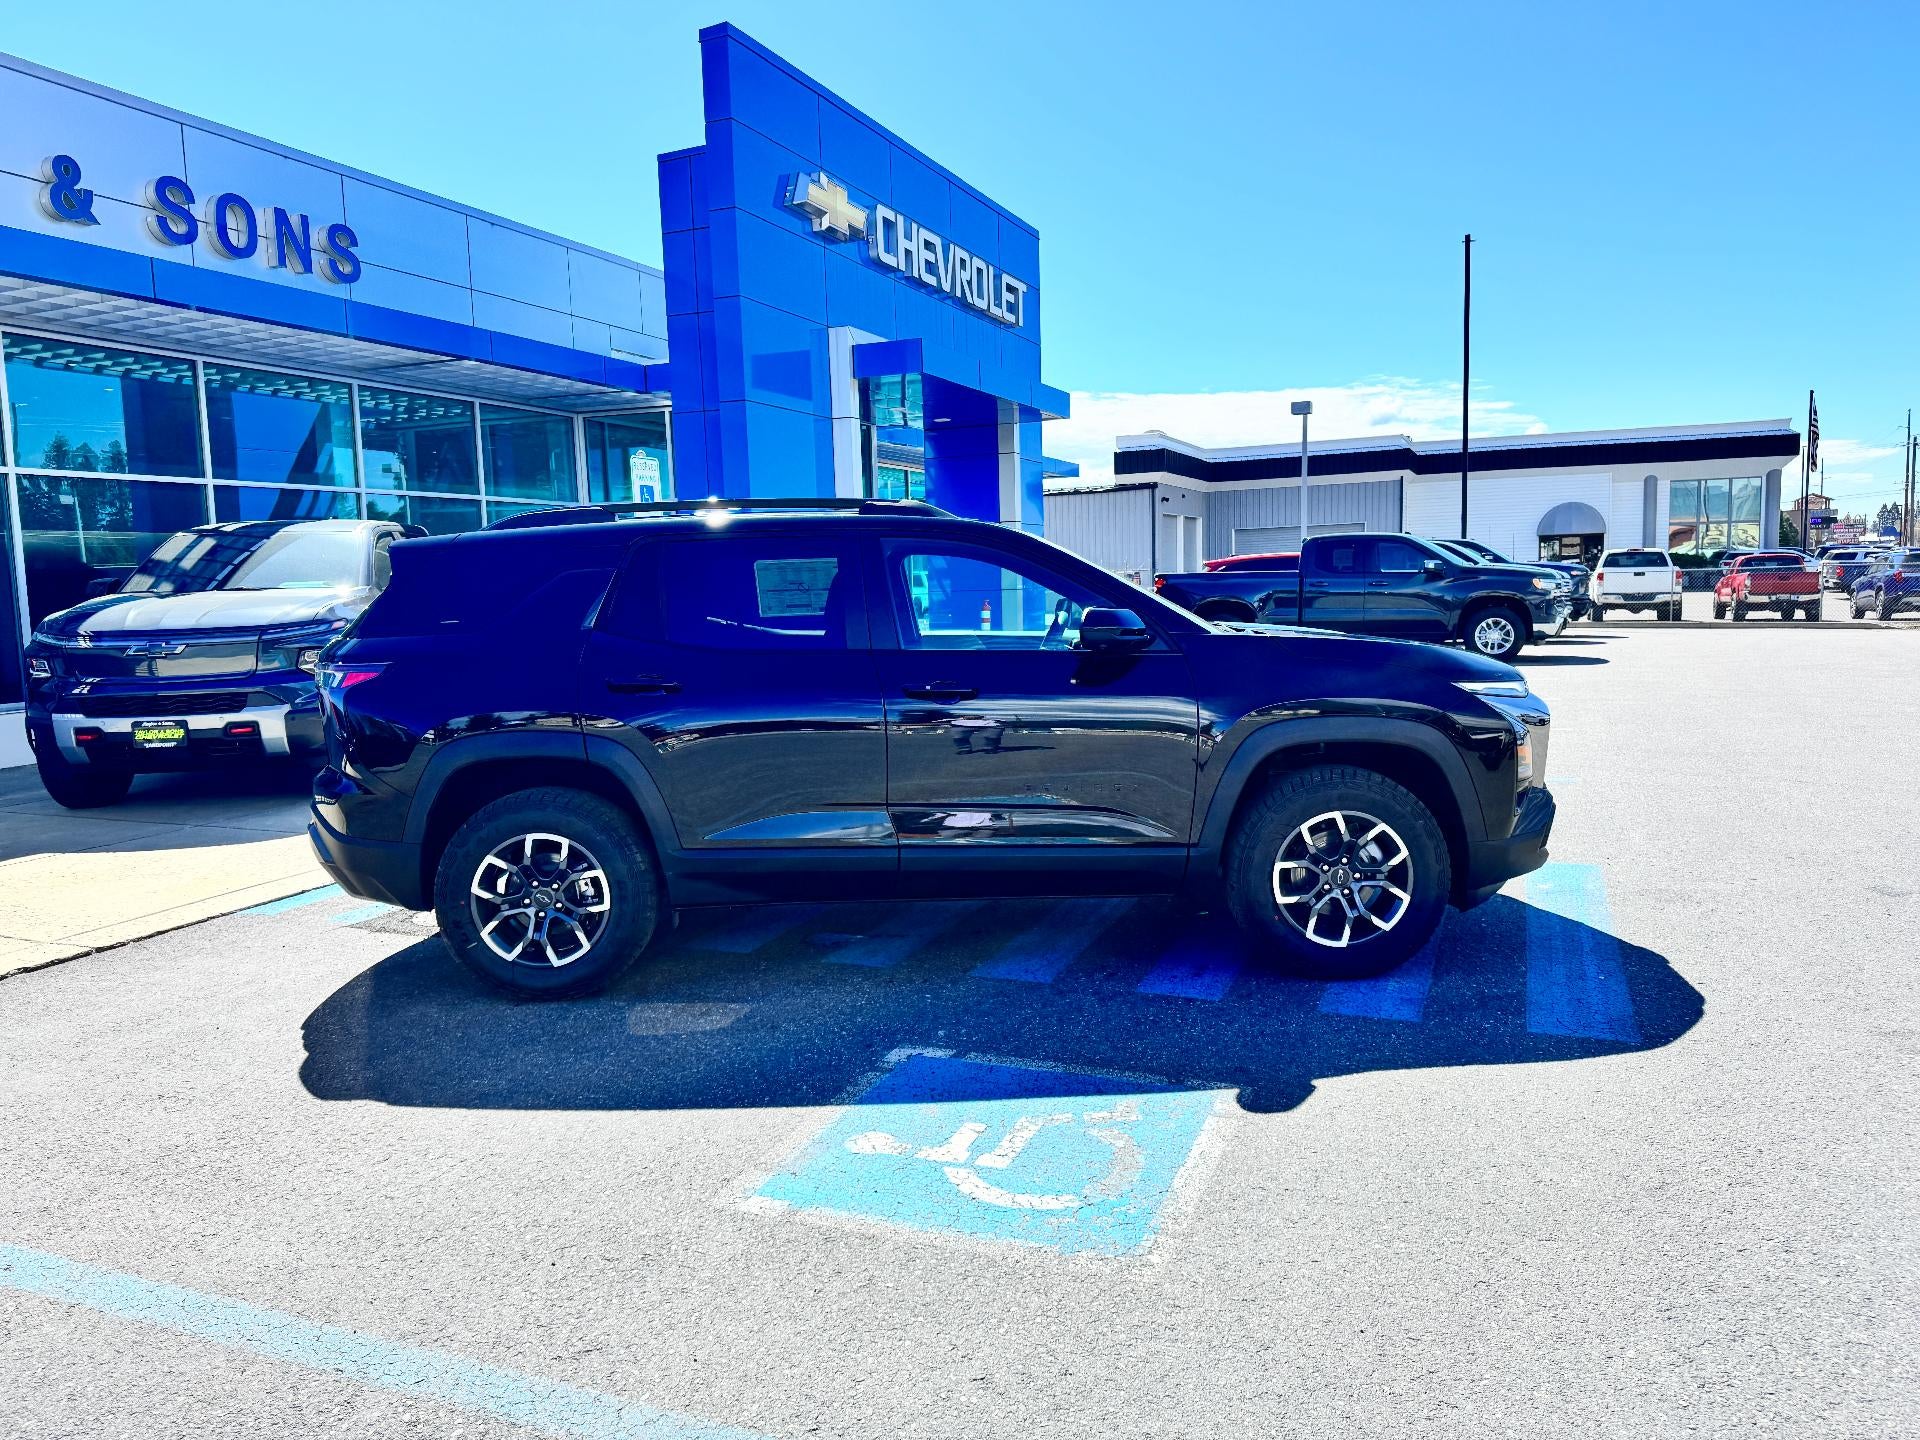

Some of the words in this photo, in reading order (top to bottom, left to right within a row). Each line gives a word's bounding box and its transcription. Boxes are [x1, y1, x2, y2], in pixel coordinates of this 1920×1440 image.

[39, 154, 101, 226] &
[145, 175, 362, 284] SONS
[875, 203, 1027, 327] CHEVROLET
